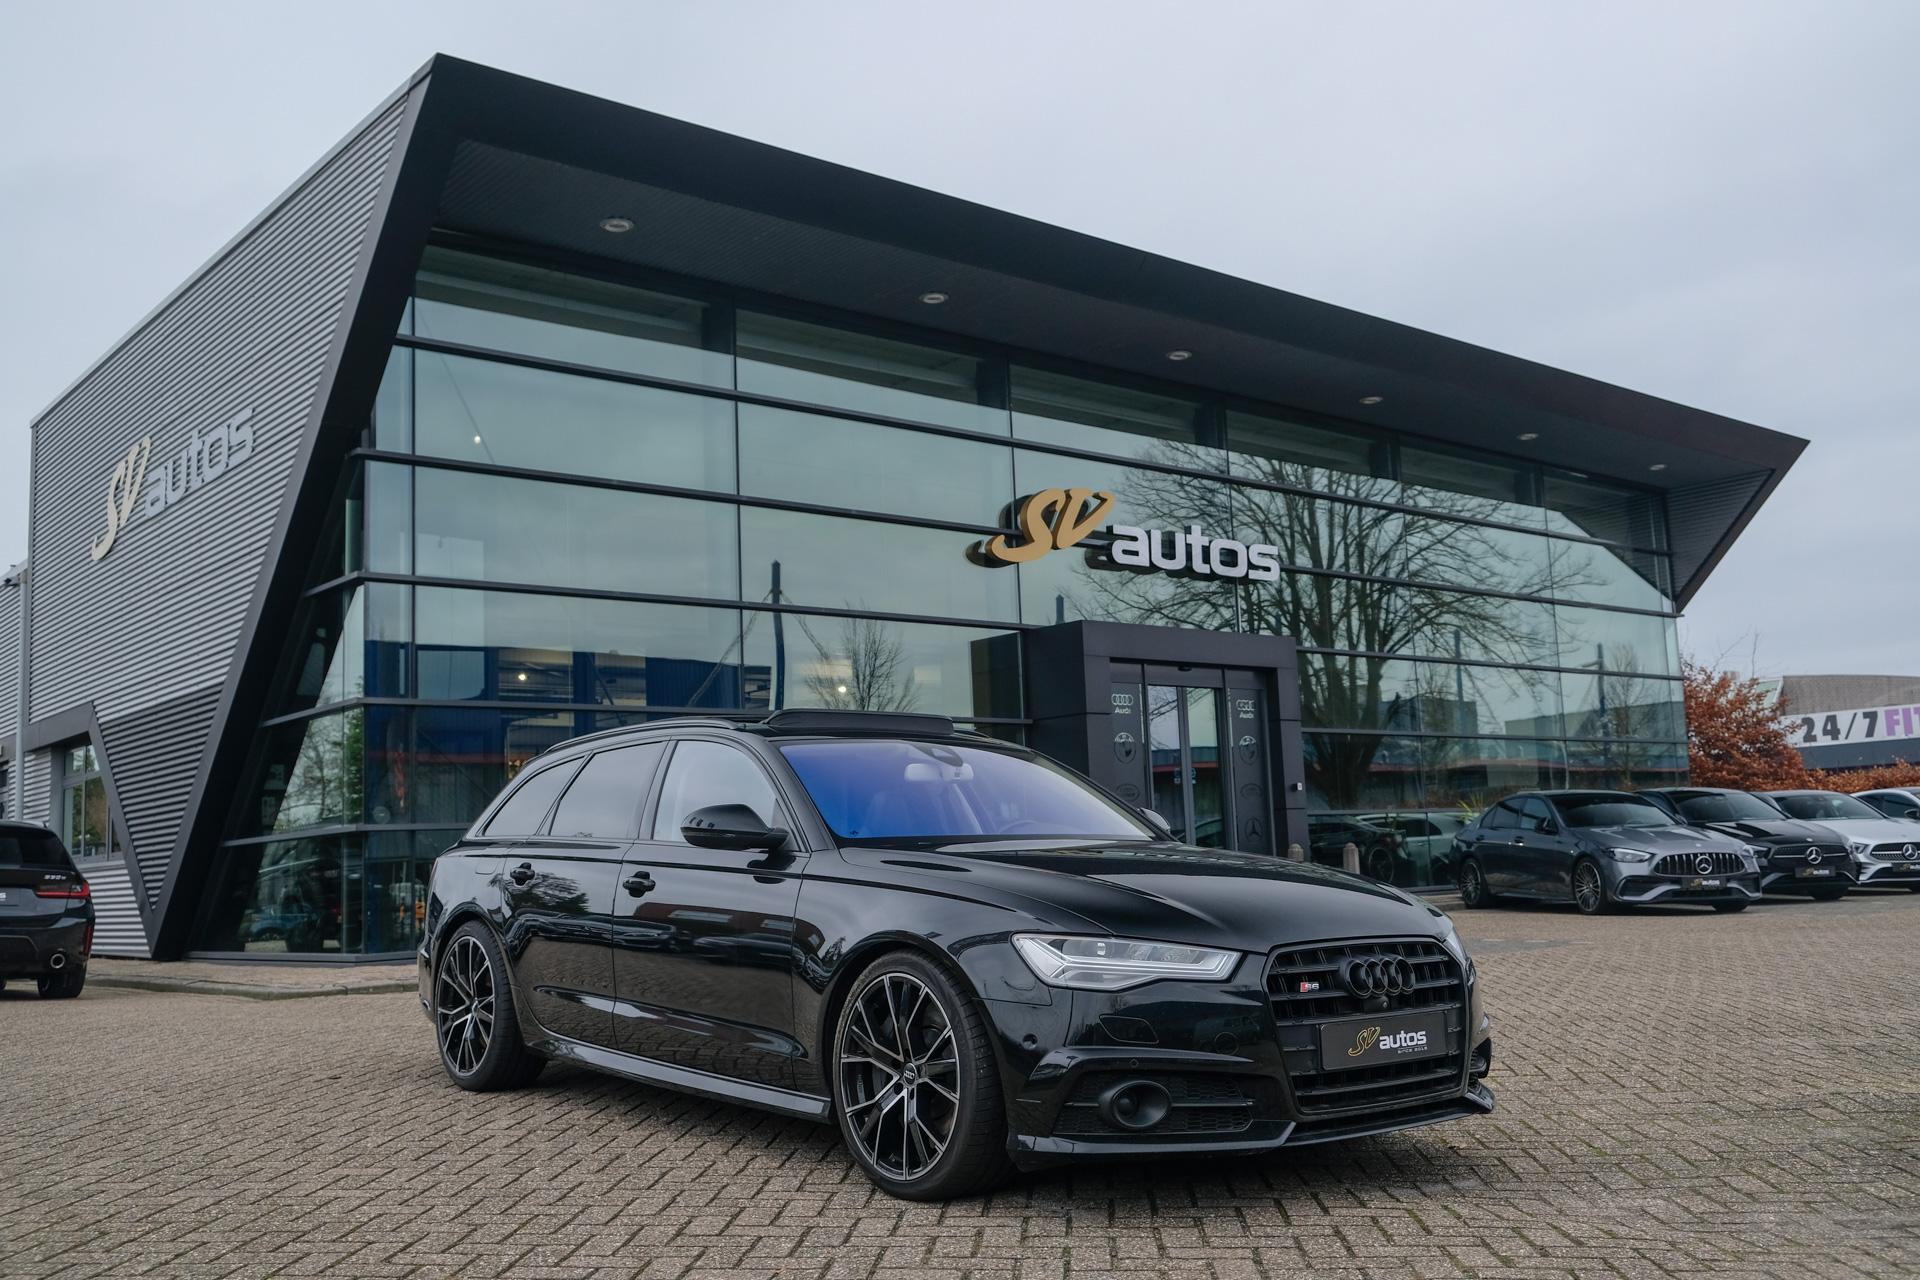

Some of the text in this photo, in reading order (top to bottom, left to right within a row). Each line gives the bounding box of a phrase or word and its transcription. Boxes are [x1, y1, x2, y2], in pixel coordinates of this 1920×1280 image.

[145, 407, 254, 519] autos
[1111, 523, 1281, 582] autos
[1801, 710, 1878, 743] 24/7
[1379, 1029, 1427, 1050] autos
